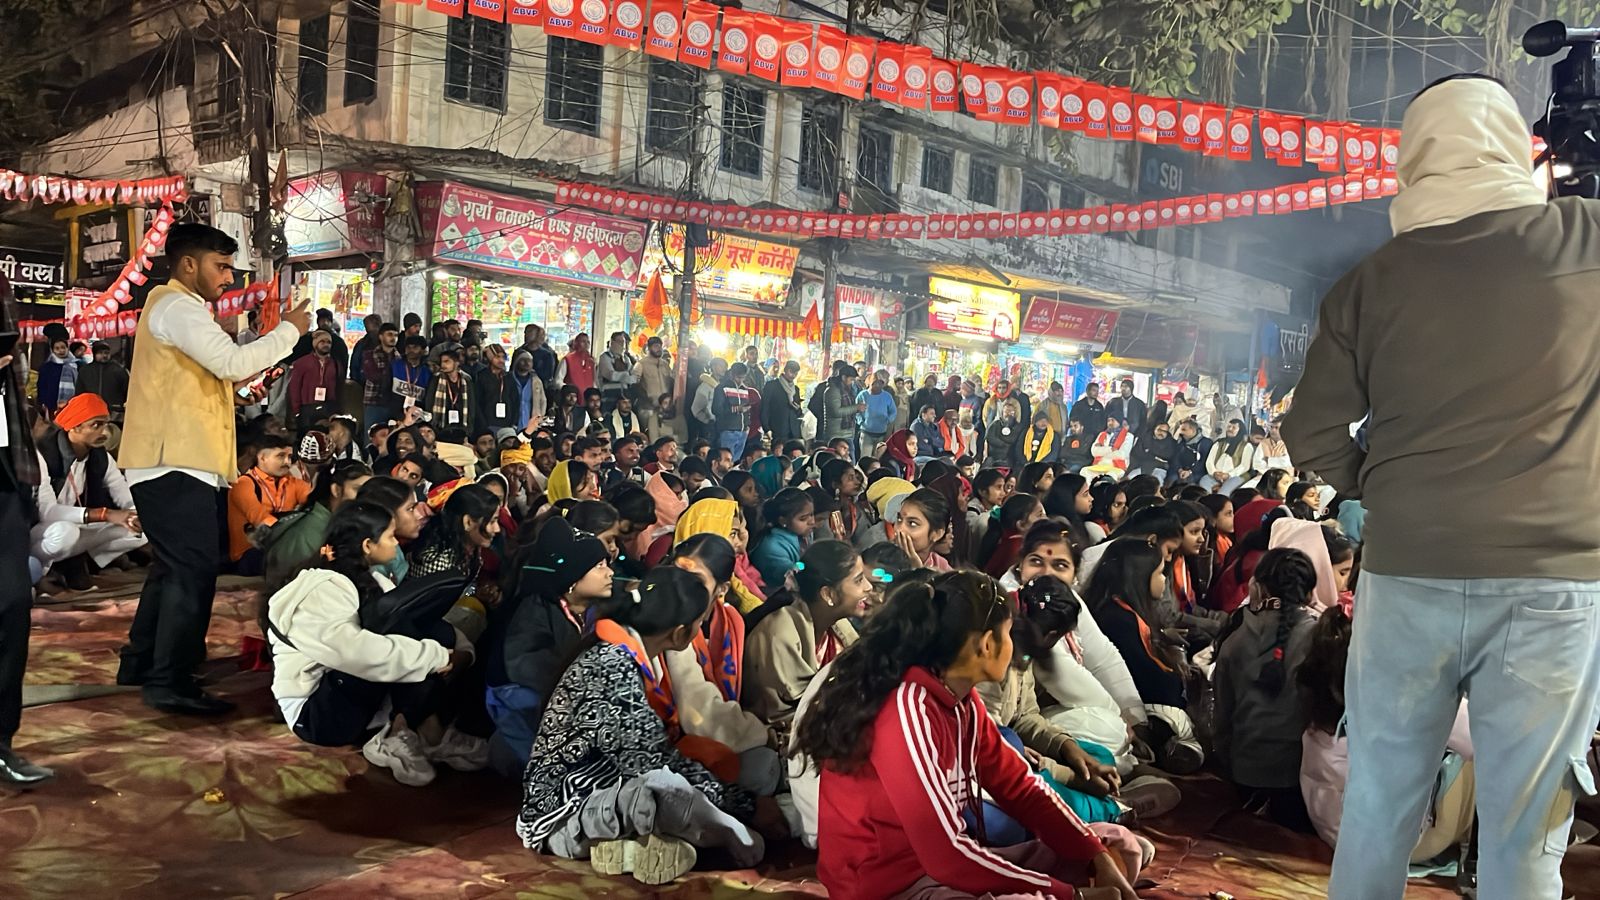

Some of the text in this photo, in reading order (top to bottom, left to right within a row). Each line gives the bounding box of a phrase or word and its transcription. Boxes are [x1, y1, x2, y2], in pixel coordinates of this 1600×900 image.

[475, 0, 500, 10] ABVP
[513, 7, 539, 16] ABVP
[548, 17, 574, 28] ABVP
[581, 23, 606, 35] ABVP
[614, 28, 638, 40] ABVP
[651, 37, 675, 49] ABVP
[685, 46, 709, 59] ABVP
[723, 53, 746, 65] ABVP
[754, 59, 776, 72] ABVP
[786, 68, 808, 78] ABVP
[816, 71, 837, 81] ABVP
[843, 78, 865, 89] ABVP
[876, 81, 898, 93] ABVP
[904, 90, 925, 100] ABVP
[935, 94, 956, 104] ABVP
[1007, 109, 1028, 118] ABVP
[1159, 162, 1183, 192] SBI
[494, 206, 546, 231] नमकीन
[548, 217, 573, 235] एण्ड
[726, 244, 756, 270] जूस
[757, 246, 795, 271] कॉर्नर
[20, 262, 56, 283] वस्त्र
